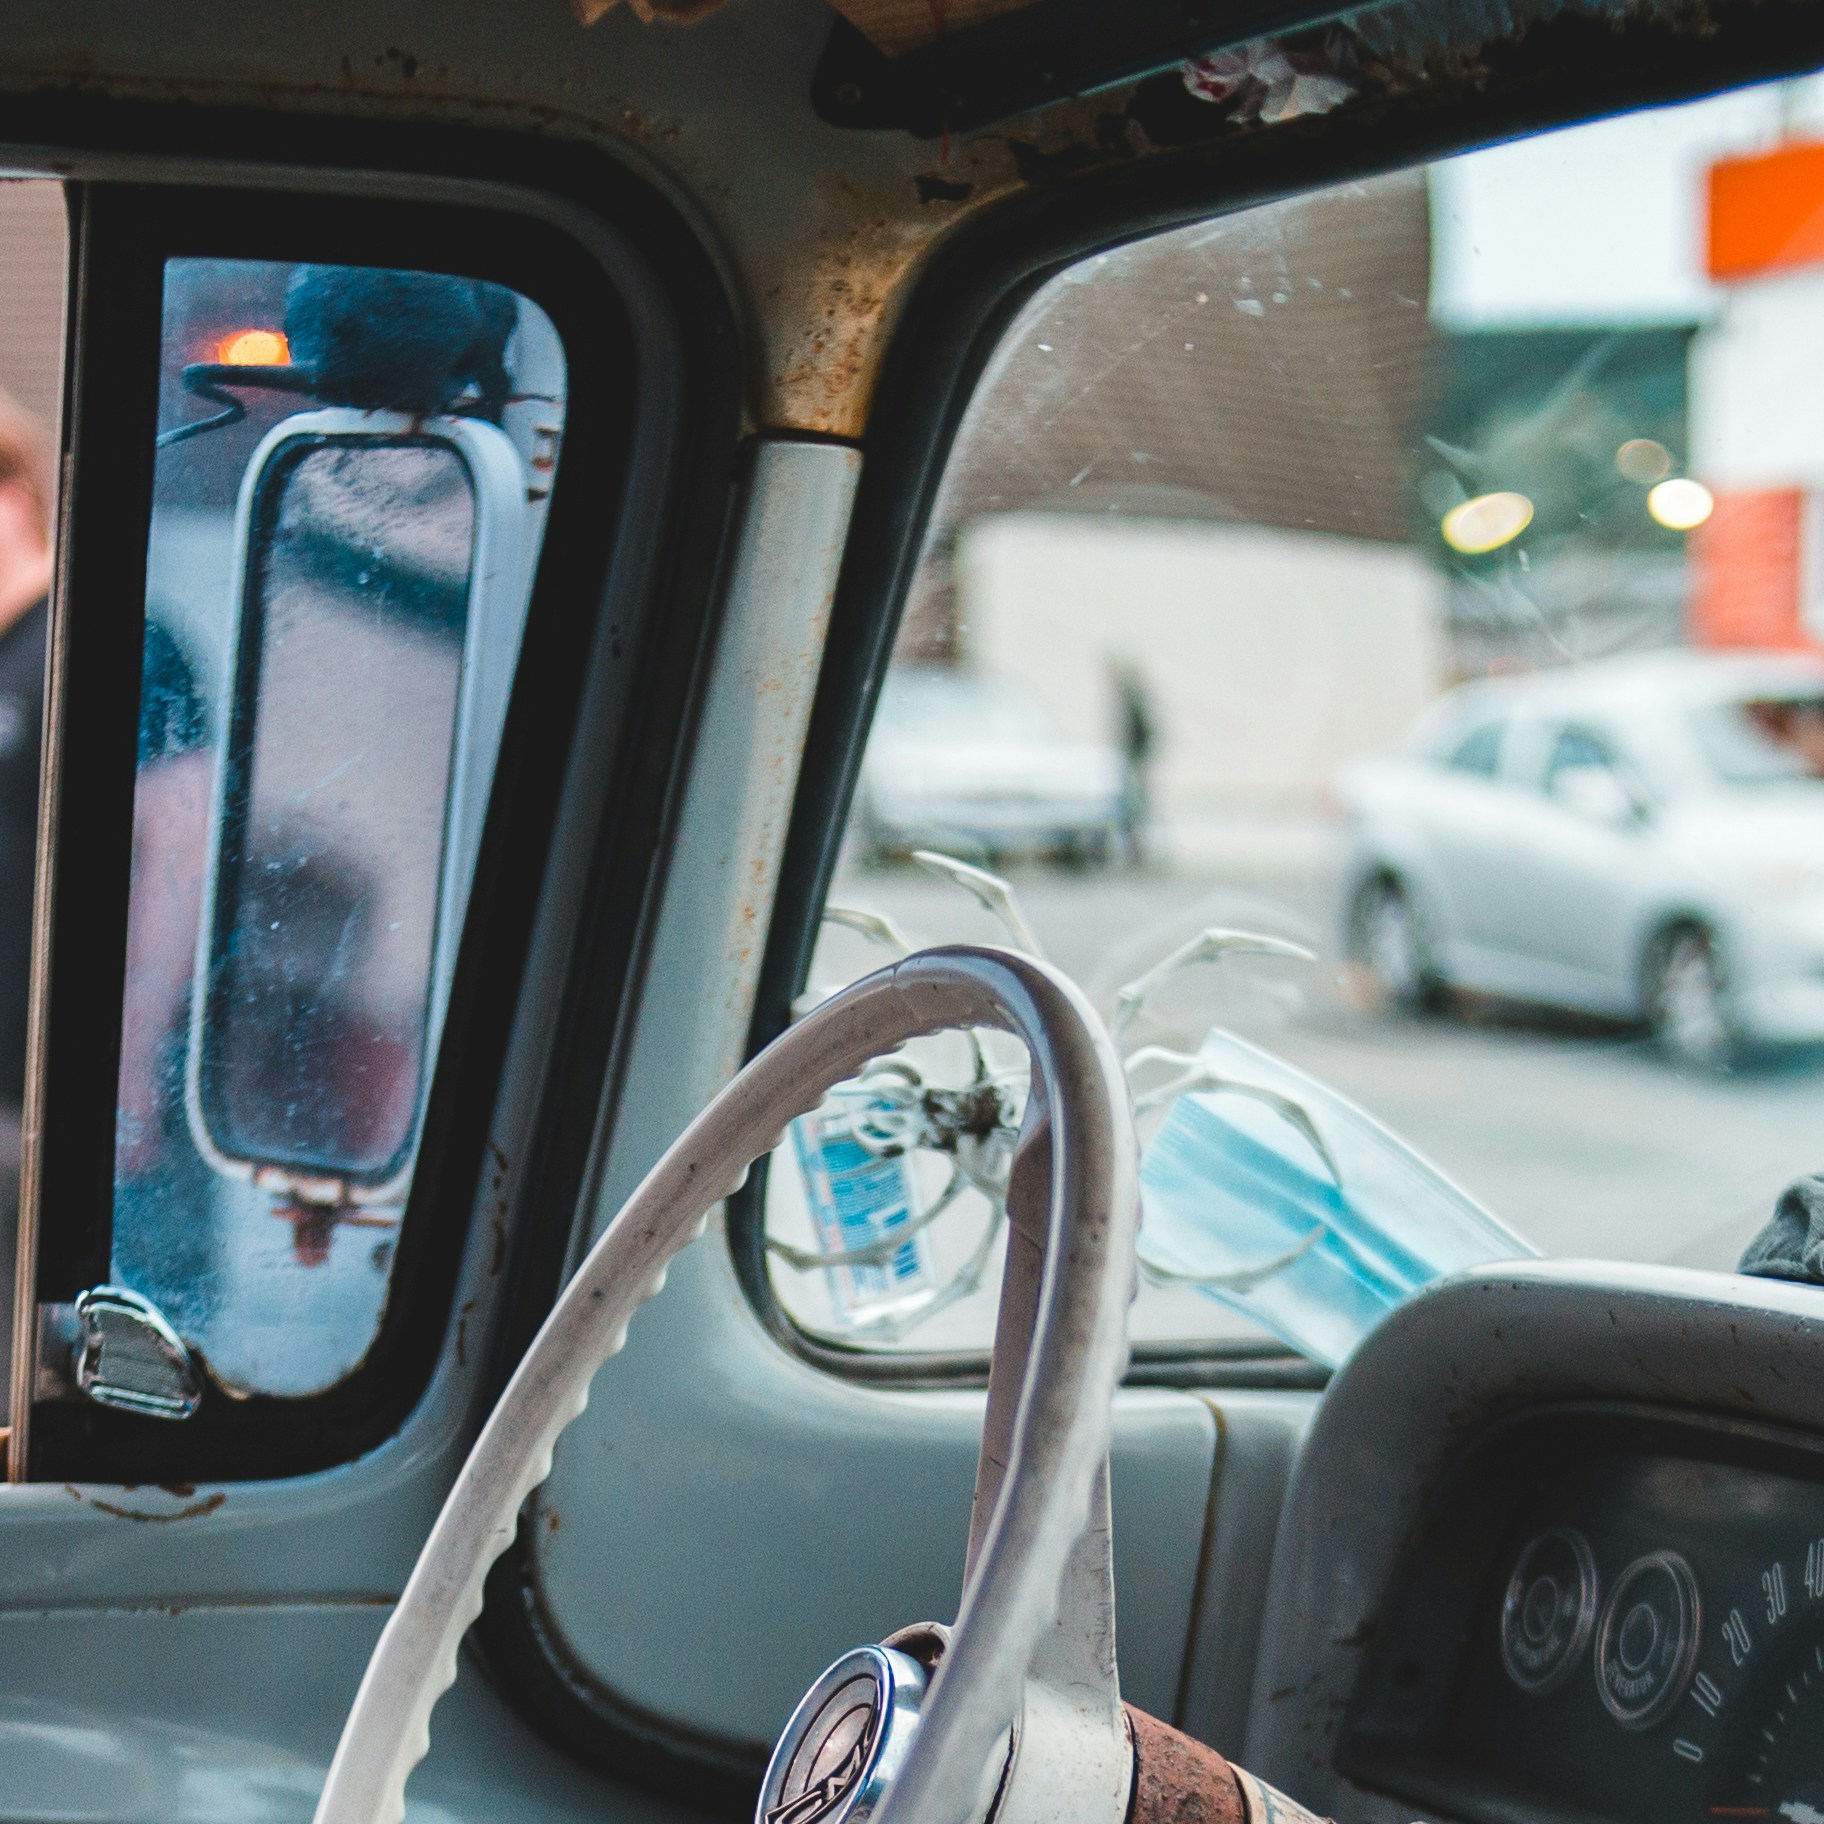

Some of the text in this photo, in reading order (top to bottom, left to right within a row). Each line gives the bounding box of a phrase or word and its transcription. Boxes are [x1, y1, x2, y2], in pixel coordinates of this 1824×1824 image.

[1761, 1562, 1787, 1625] 30
[1721, 1608, 1752, 1667] 20
[1689, 1671, 1723, 1718] 10
[1672, 1737, 1704, 1763] 0
